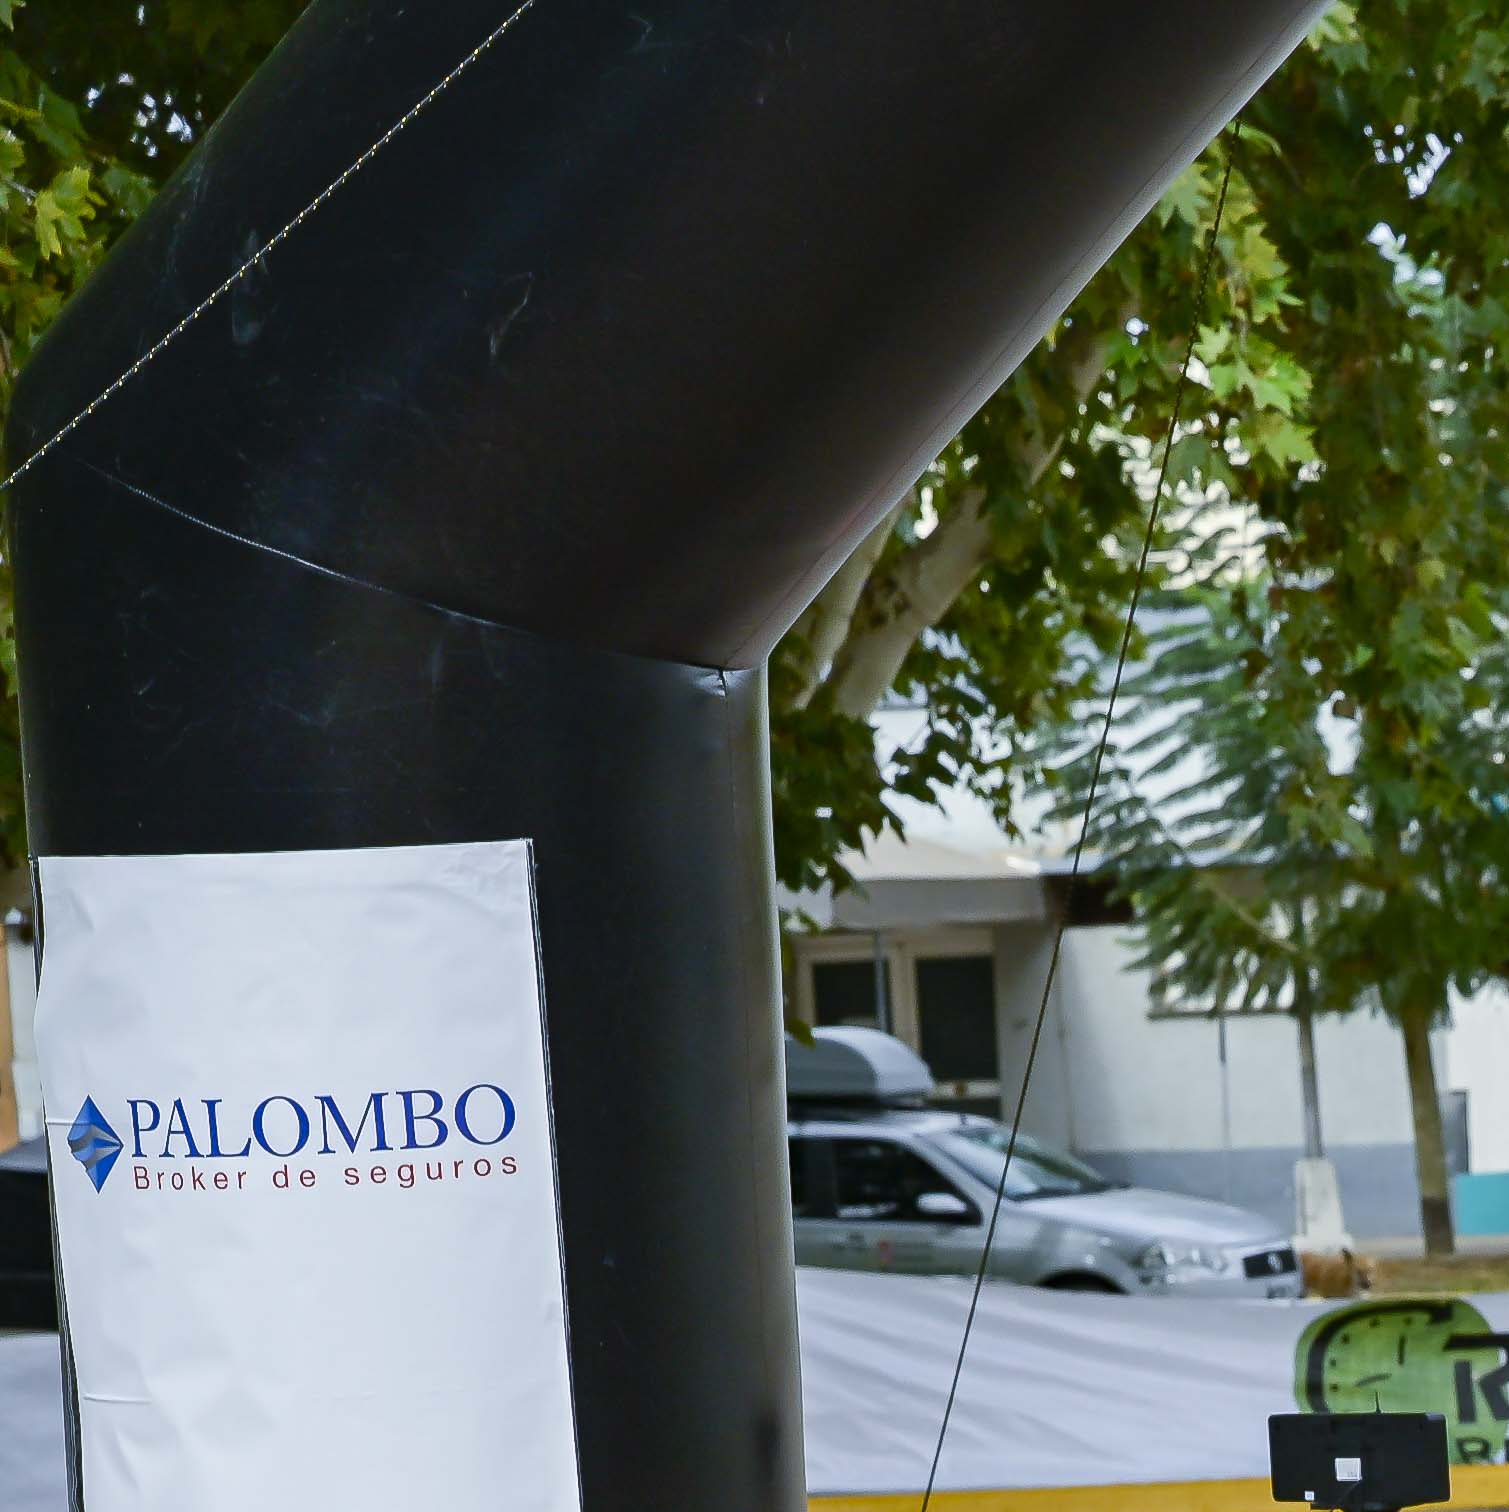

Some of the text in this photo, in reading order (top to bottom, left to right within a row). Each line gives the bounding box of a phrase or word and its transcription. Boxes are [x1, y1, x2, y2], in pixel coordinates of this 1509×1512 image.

[127, 1084, 516, 1159] PALOMBO
[134, 1153, 518, 1191] Broker de seguros
